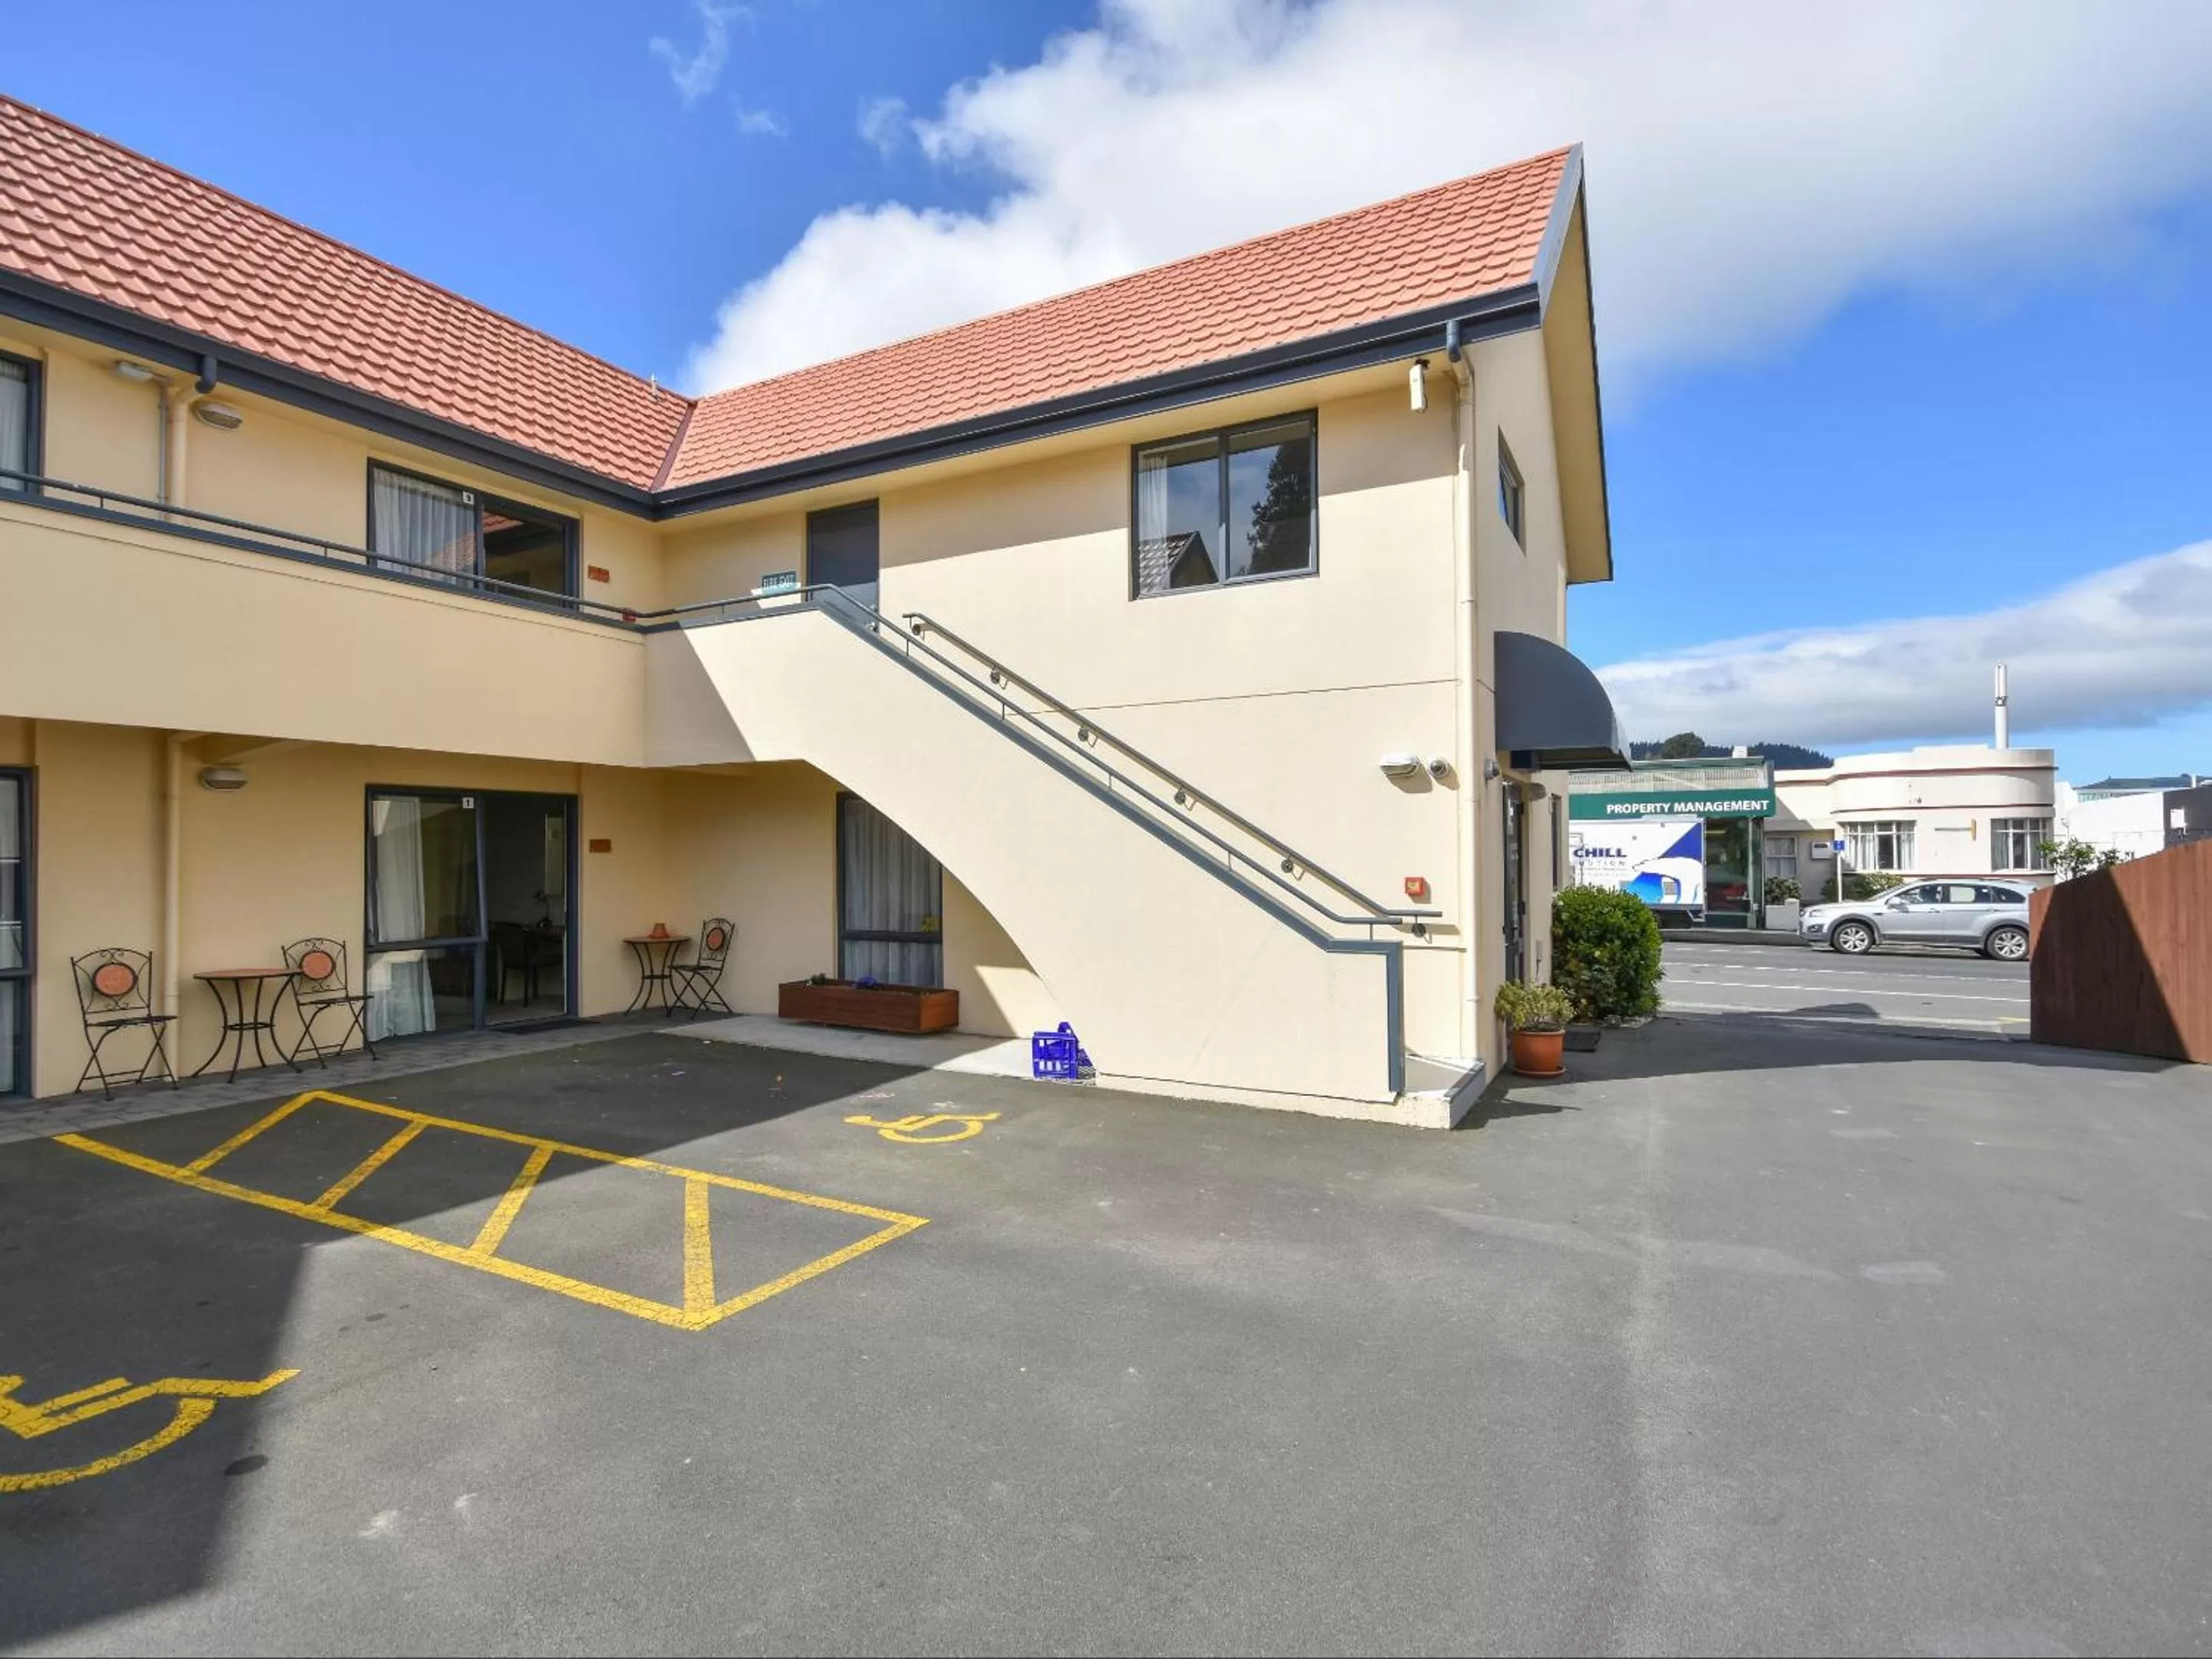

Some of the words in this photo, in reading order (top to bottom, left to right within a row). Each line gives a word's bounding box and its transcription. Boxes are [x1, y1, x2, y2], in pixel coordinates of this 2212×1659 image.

[1606, 803, 1671, 814] PROPERTY
[1674, 800, 1770, 813] MANAGEMENT
[1572, 847, 1628, 858] CHILL
